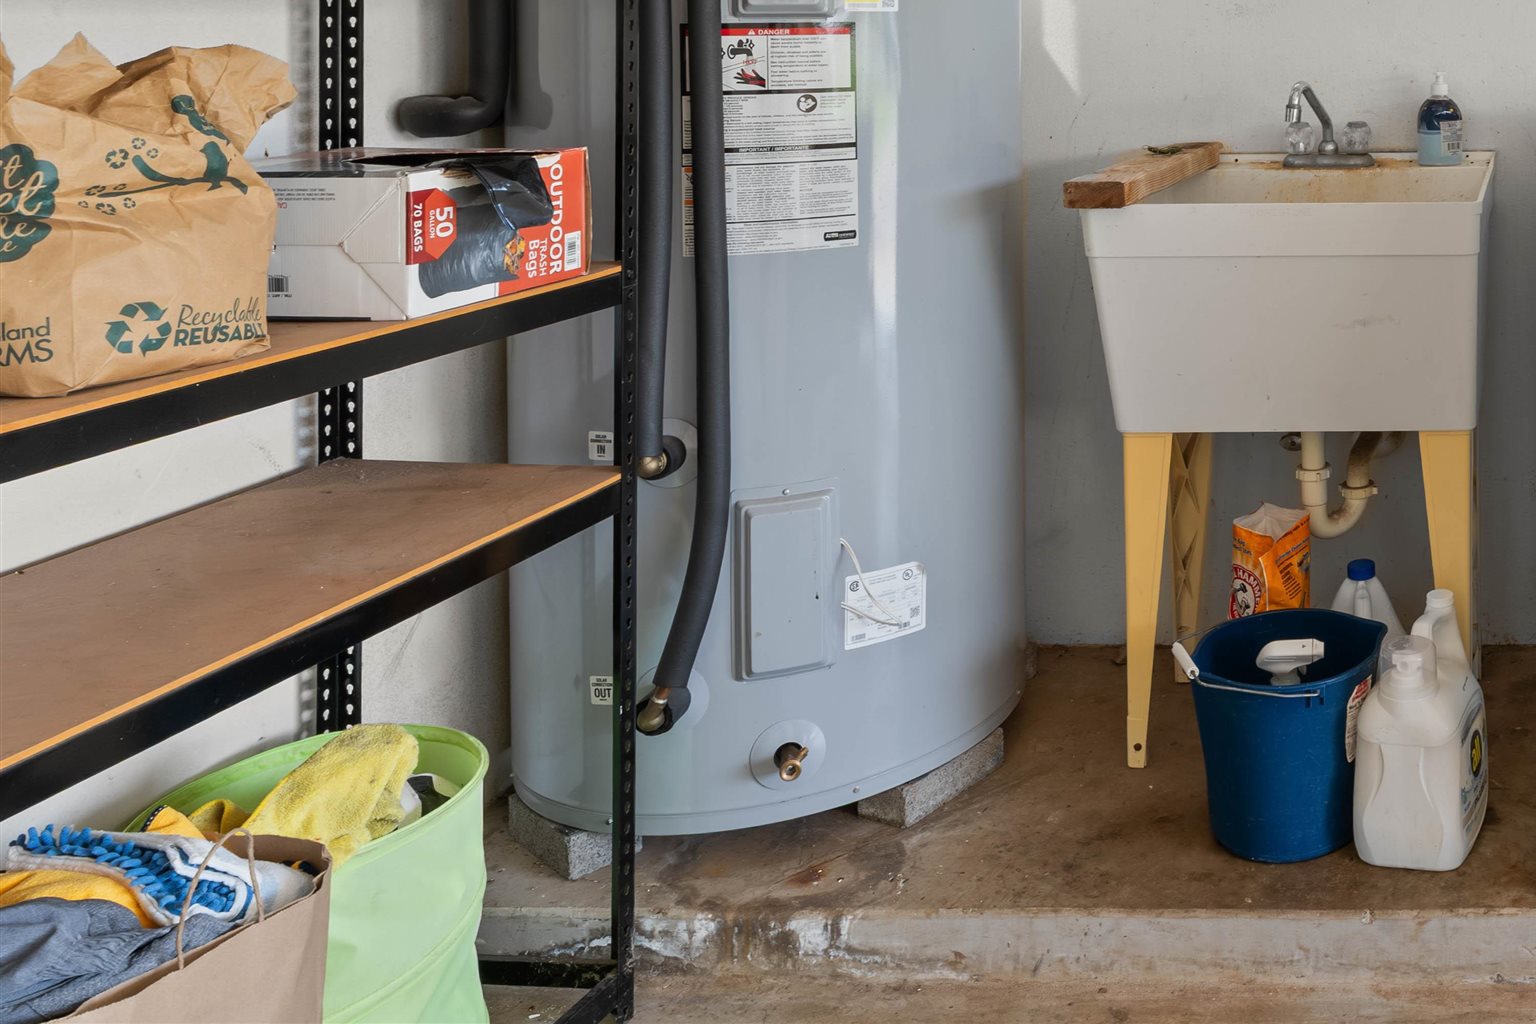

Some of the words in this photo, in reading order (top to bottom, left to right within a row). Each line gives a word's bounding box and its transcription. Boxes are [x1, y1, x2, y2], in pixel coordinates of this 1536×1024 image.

[413, 202, 423, 218] 70
[435, 206, 454, 238] 50
[550, 163, 563, 274] OUTDOOR
[413, 220, 424, 253] BAGS
[525, 239, 540, 278] Bags
[538, 237, 548, 276] TRASH
[176, 296, 262, 329] Recyclable
[596, 444, 606, 454] IN
[594, 688, 612, 698] OUT
